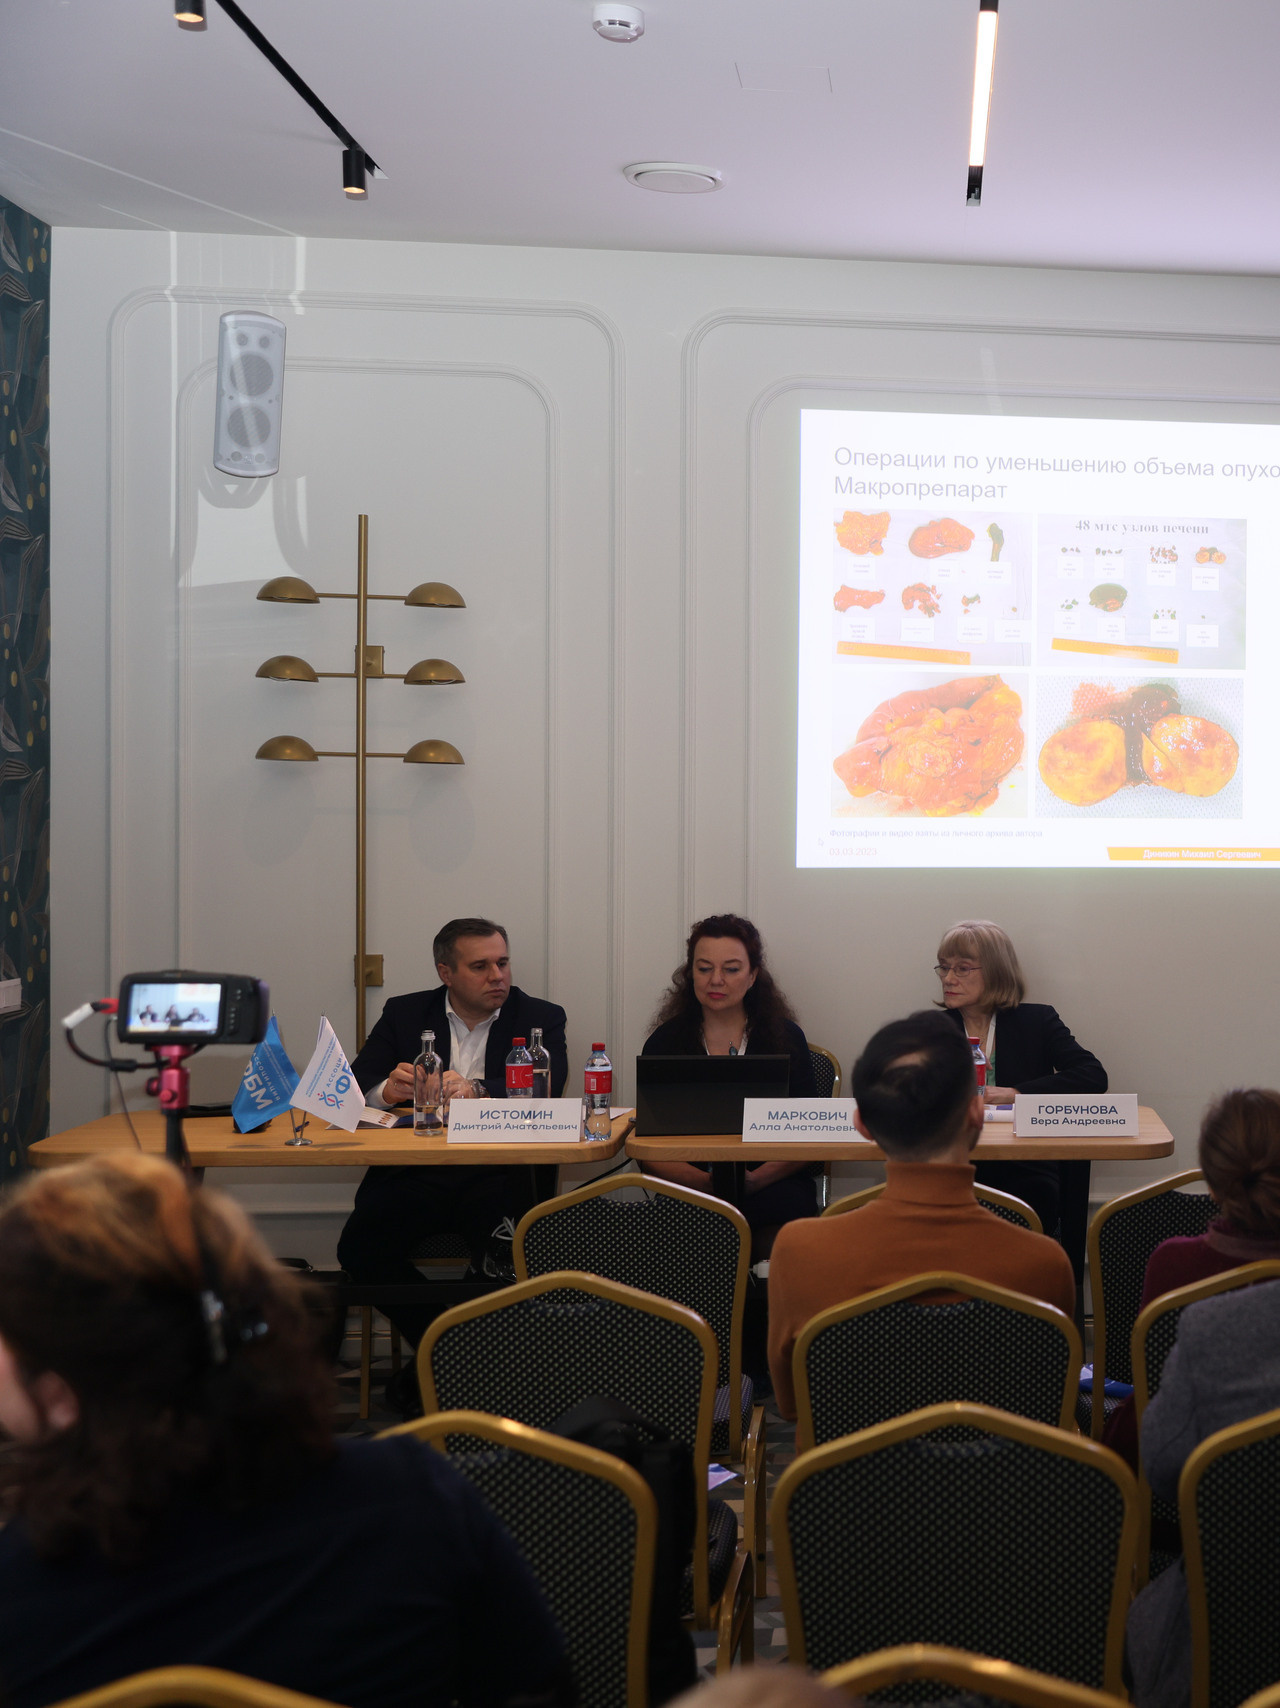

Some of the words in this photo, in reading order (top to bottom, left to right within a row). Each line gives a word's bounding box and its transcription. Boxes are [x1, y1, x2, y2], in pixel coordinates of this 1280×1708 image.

[833, 446, 947, 471] Операции
[953, 453, 979, 469] по
[985, 455, 1127, 474] уменьшению
[1132, 456, 1215, 476] объема
[833, 475, 1008, 502] Макропрепарат
[1075, 519, 1090, 531] 48
[1094, 522, 1117, 532] мтс
[1122, 523, 1159, 535] узлов
[1163, 524, 1209, 534] печени
[829, 829, 880, 838] Фотографии
[1181, 849, 1214, 858] Михаил
[1215, 850, 1261, 860] Сергеевич
[479, 1110, 553, 1120] ИСТОМИН
[1038, 1105, 1118, 1115] ГОРБУНОВА
[768, 1110, 848, 1121] МАРКОВИЧ
[452, 1122, 502, 1132] Дмитрий
[503, 1122, 578, 1131] Анатольевич
[749, 1122, 781, 1131] Алла
[783, 1122, 857, 1132] Анатольевн
[1030, 1117, 1059, 1127] Вера
[1061, 1117, 1126, 1127] Андреевна
